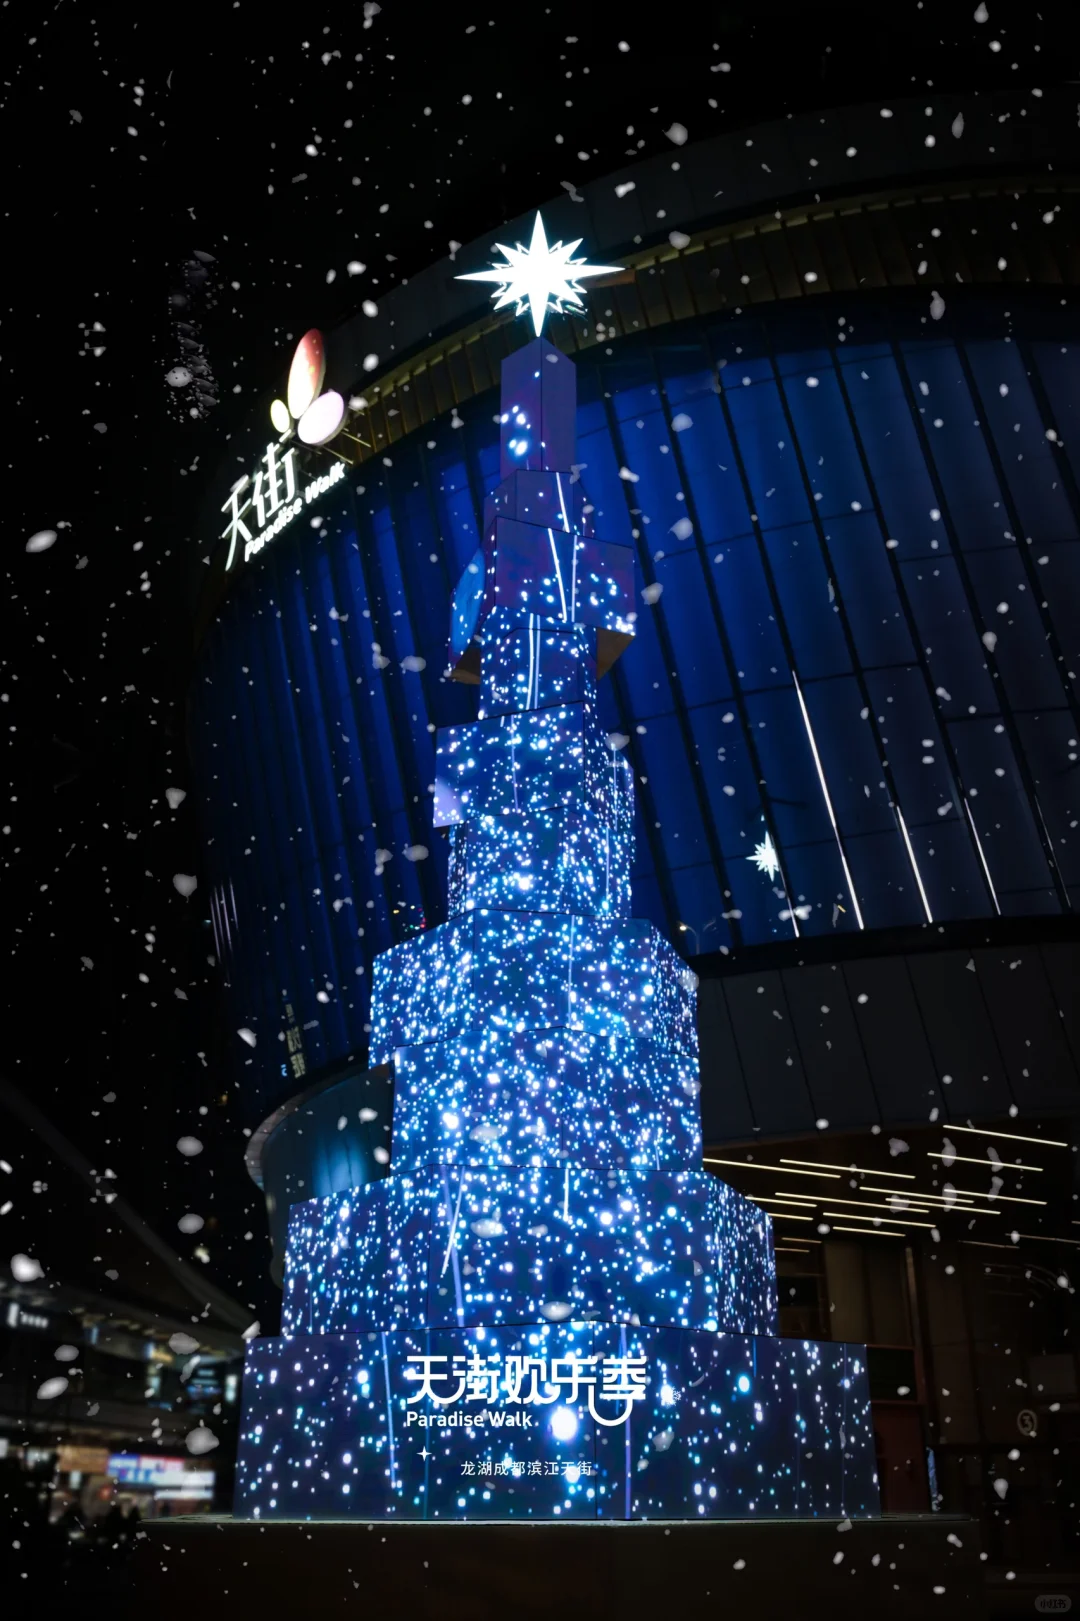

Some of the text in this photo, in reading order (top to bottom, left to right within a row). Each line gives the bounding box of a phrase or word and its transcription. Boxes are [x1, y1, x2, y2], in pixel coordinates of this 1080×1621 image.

[221, 429, 296, 571] 天街
[245, 462, 345, 562] Paradise Walk
